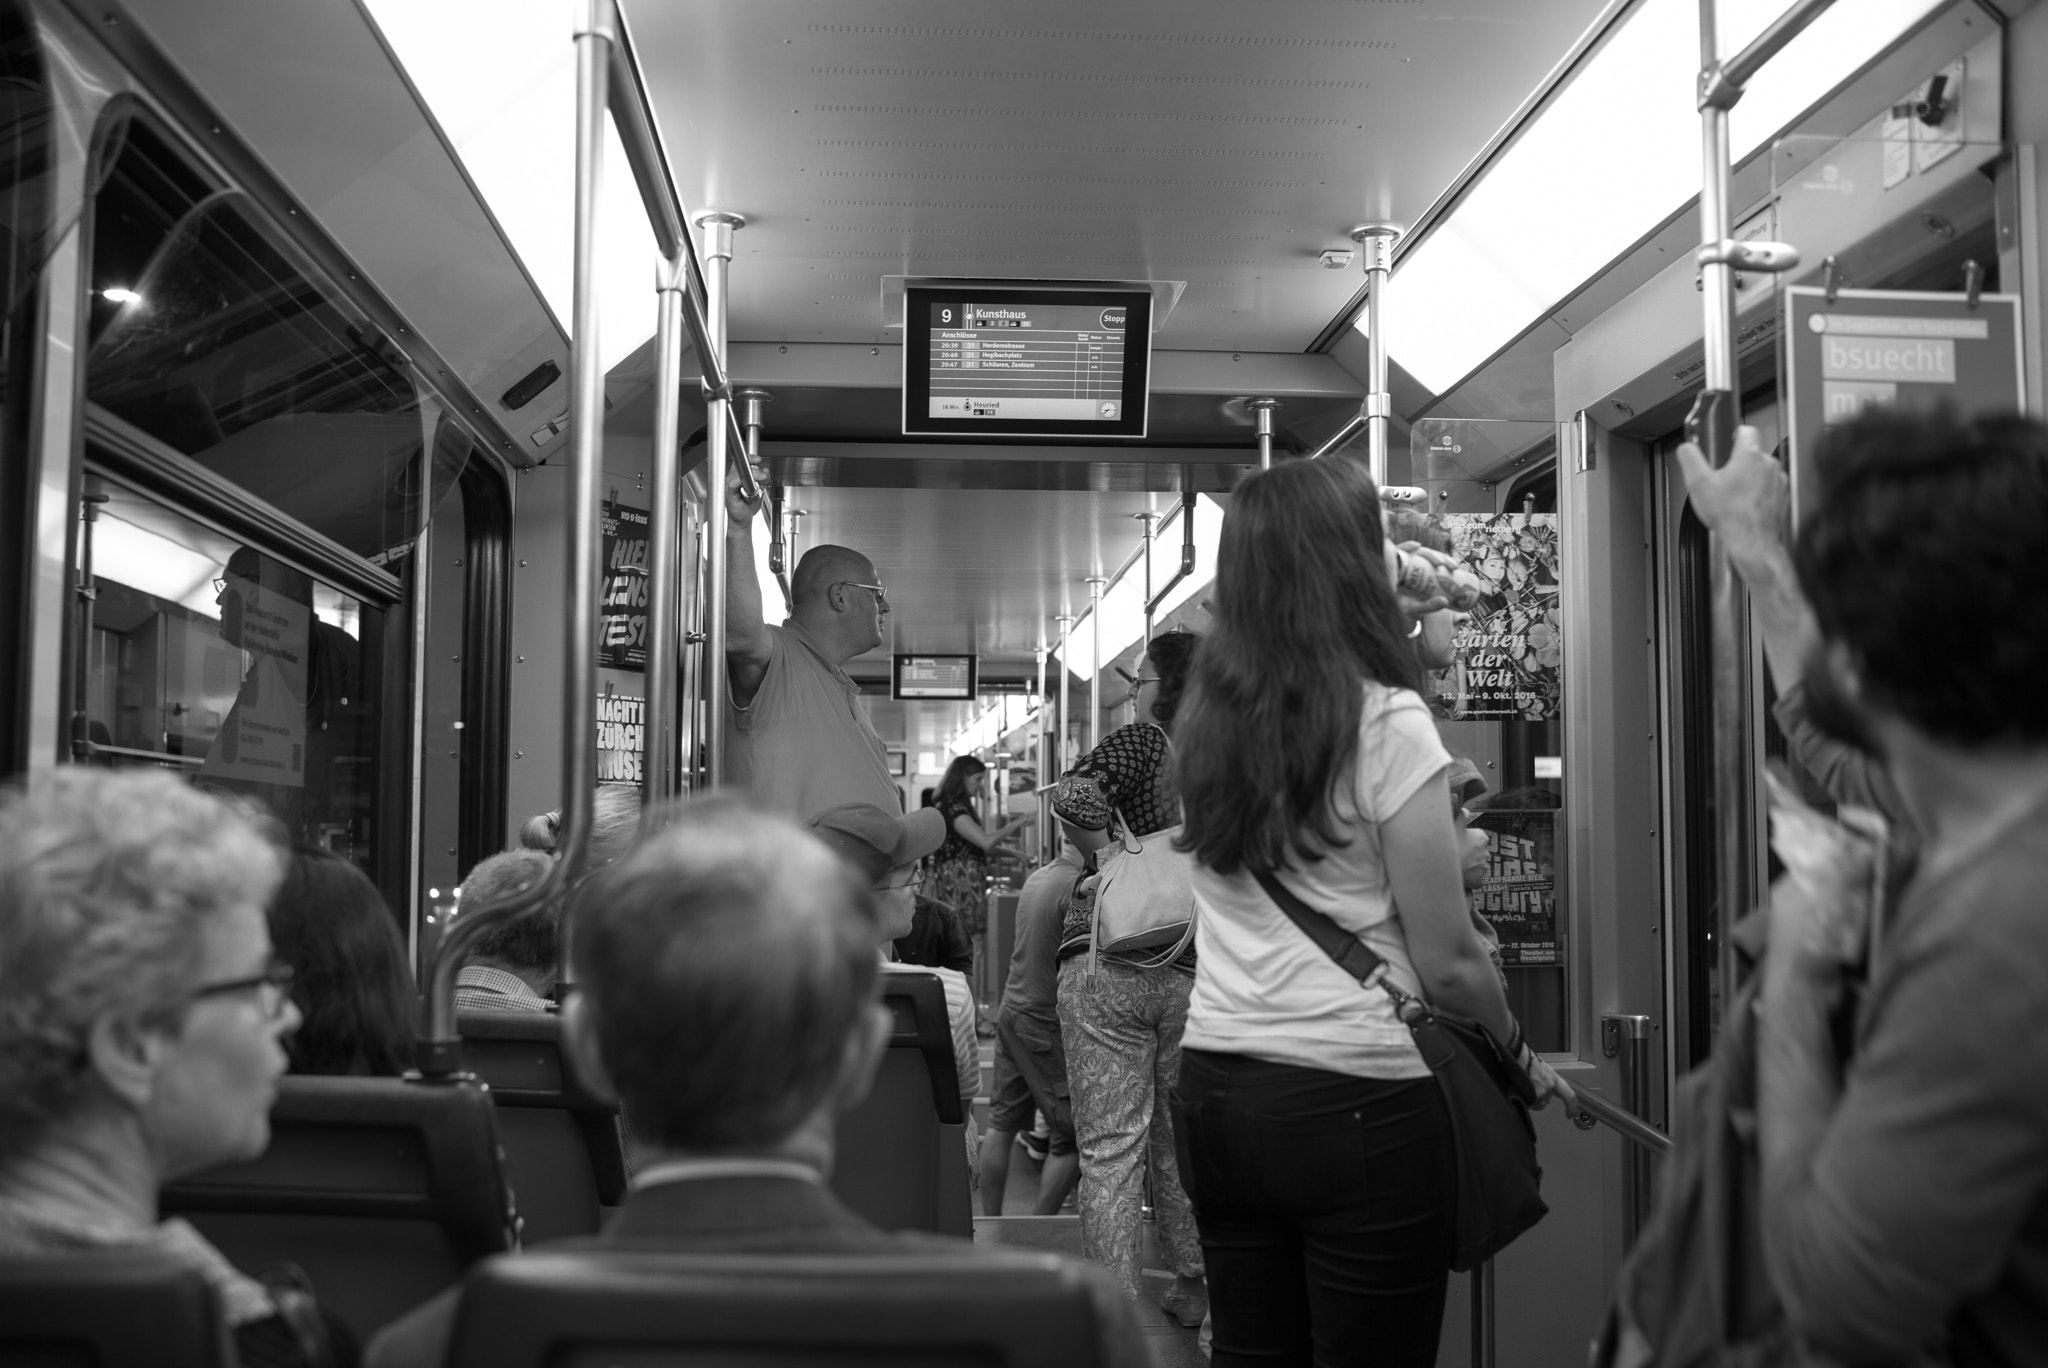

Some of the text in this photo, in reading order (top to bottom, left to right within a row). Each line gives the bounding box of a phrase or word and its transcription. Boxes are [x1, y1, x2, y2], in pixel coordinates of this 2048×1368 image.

[941, 309, 952, 323] 9
[976, 309, 1027, 319] Kunsthaus
[1104, 314, 1126, 324] Stopp
[941, 331, 978, 339] Anschlüsse
[1830, 339, 1947, 373] bsuecht
[1485, 526, 1521, 534] rietberg
[599, 614, 648, 647] TEST
[1452, 627, 1526, 648] Gärten
[1471, 649, 1508, 667] der
[1466, 668, 1514, 687] Welt
[1442, 692, 1456, 700] 13.
[1482, 692, 1491, 700] 9.
[1493, 692, 1511, 700] Okt.
[597, 698, 638, 724] NACHT
[597, 721, 645, 751] ZÜRCH
[598, 750, 643, 781] MUSE
